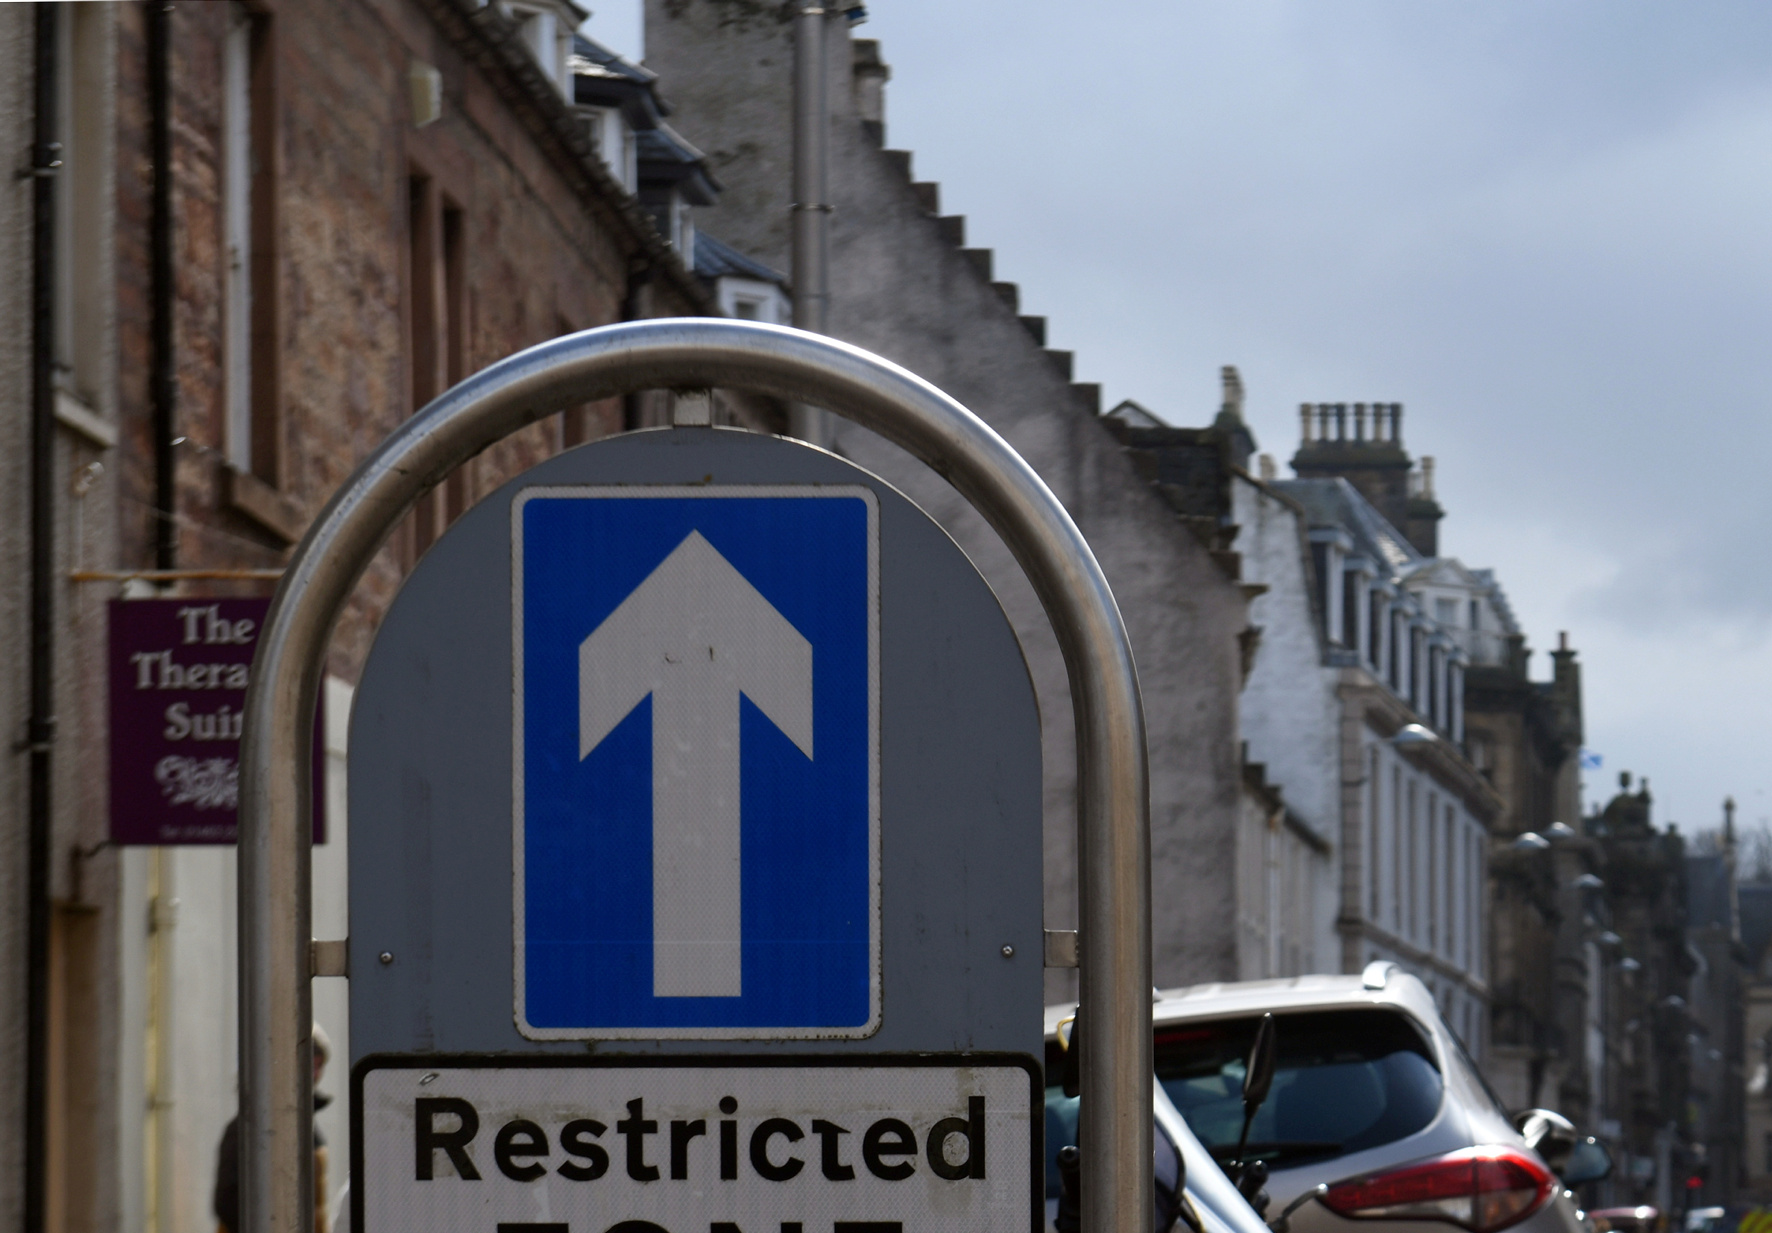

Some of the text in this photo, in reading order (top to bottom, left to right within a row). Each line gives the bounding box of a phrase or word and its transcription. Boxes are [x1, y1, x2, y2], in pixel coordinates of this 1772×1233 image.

[177, 604, 255, 645] The
[130, 648, 249, 690] Thera
[163, 701, 243, 741] Suit
[414, 1096, 987, 1183] Restricted
